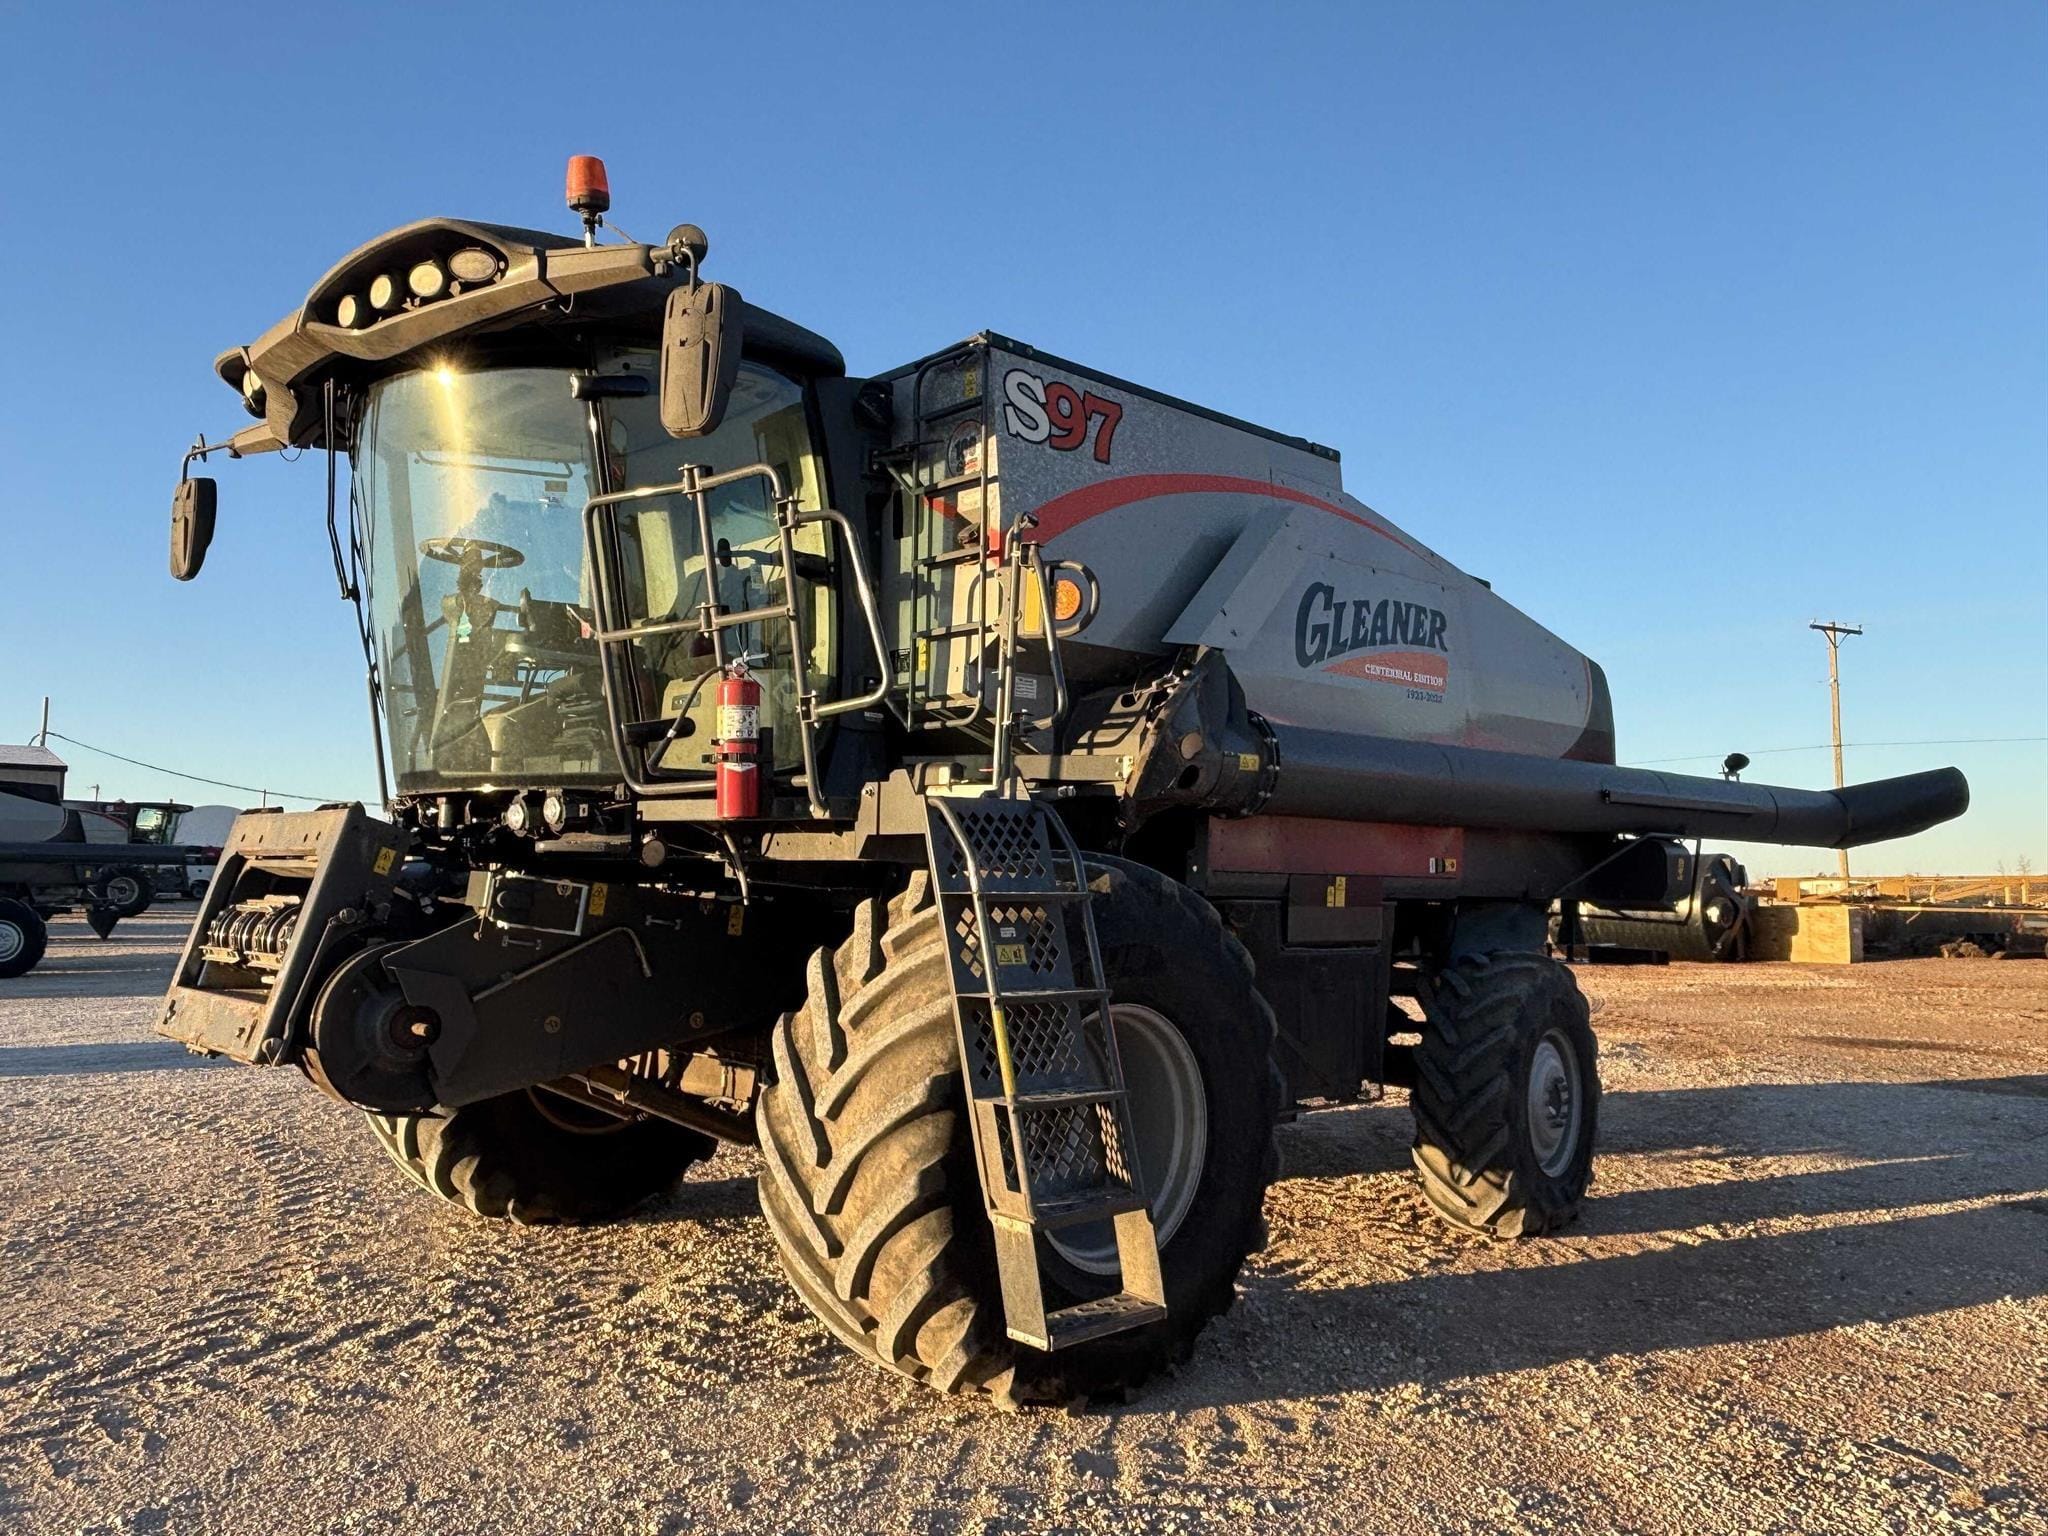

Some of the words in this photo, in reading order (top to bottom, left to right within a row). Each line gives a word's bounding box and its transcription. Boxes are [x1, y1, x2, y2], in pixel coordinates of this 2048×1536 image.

[1003, 368, 1123, 465] S97
[1295, 581, 1448, 669] GLEANER
[1365, 663, 1412, 681] CENTENNIAL
[1413, 672, 1444, 687] EDITION
